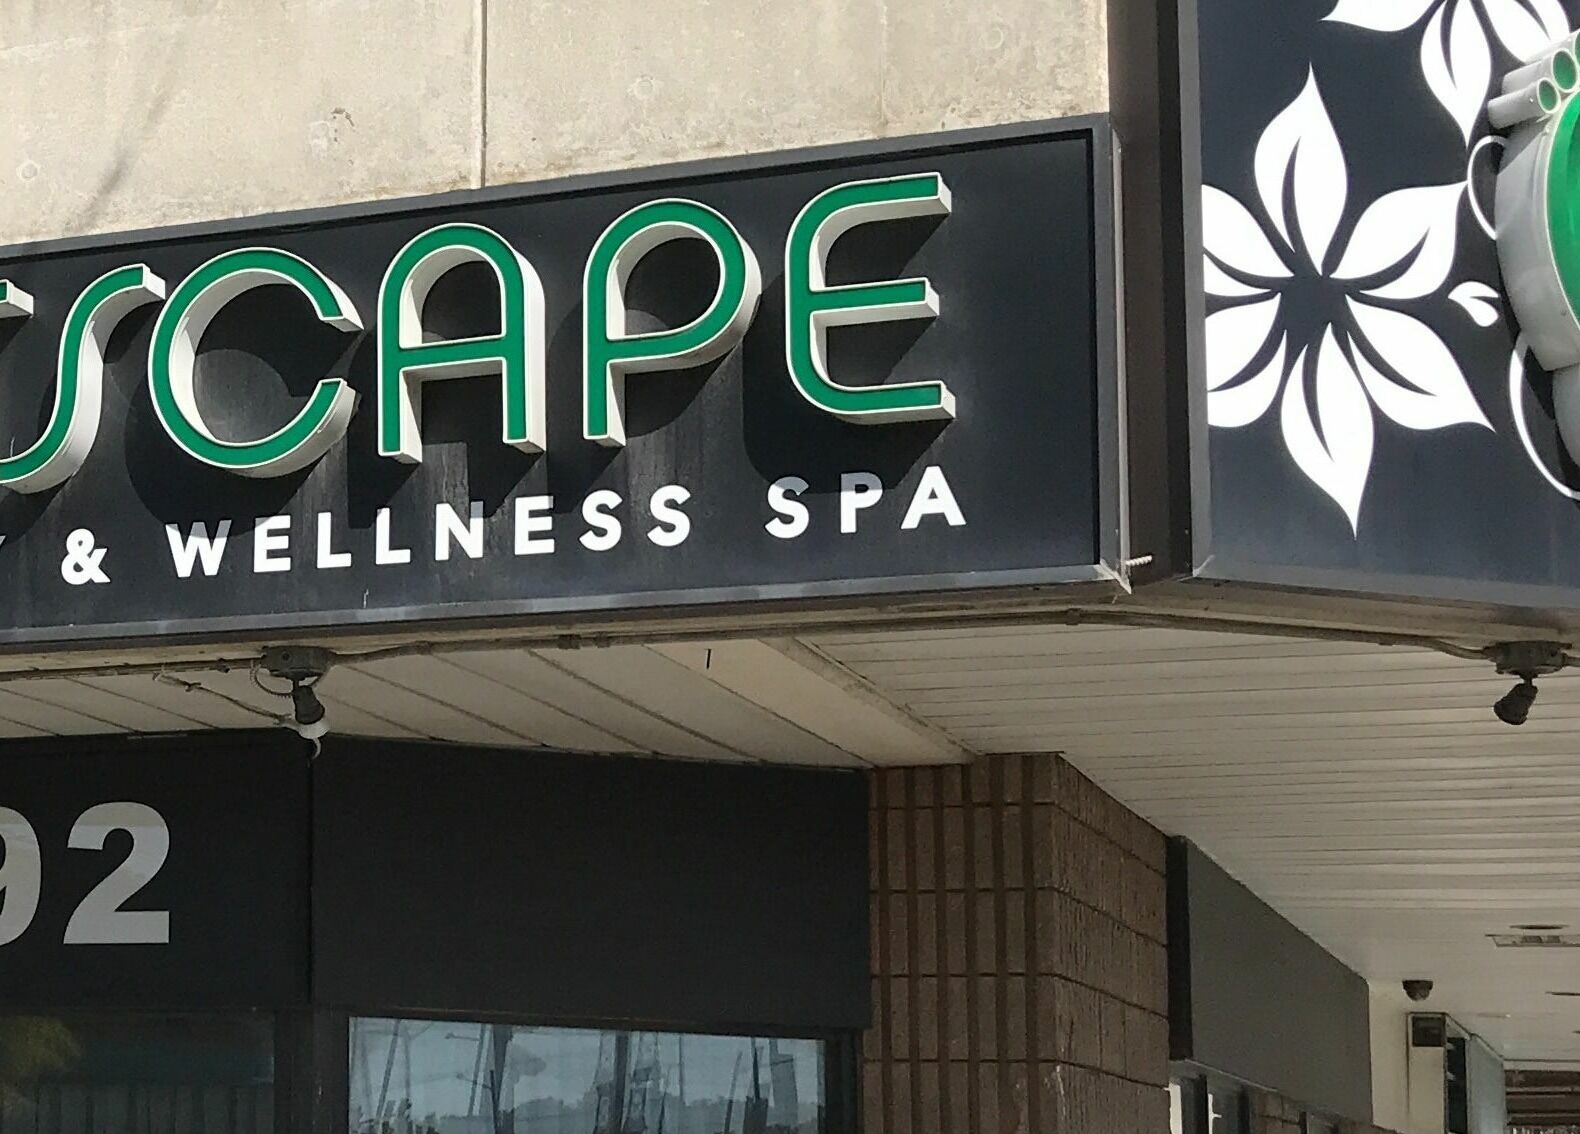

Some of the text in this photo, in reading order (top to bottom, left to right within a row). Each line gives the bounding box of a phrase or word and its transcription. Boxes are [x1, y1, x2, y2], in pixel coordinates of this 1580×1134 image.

[60, 527, 111, 585] &
[165, 484, 692, 578] WELLNESS
[764, 465, 966, 535] SPA
